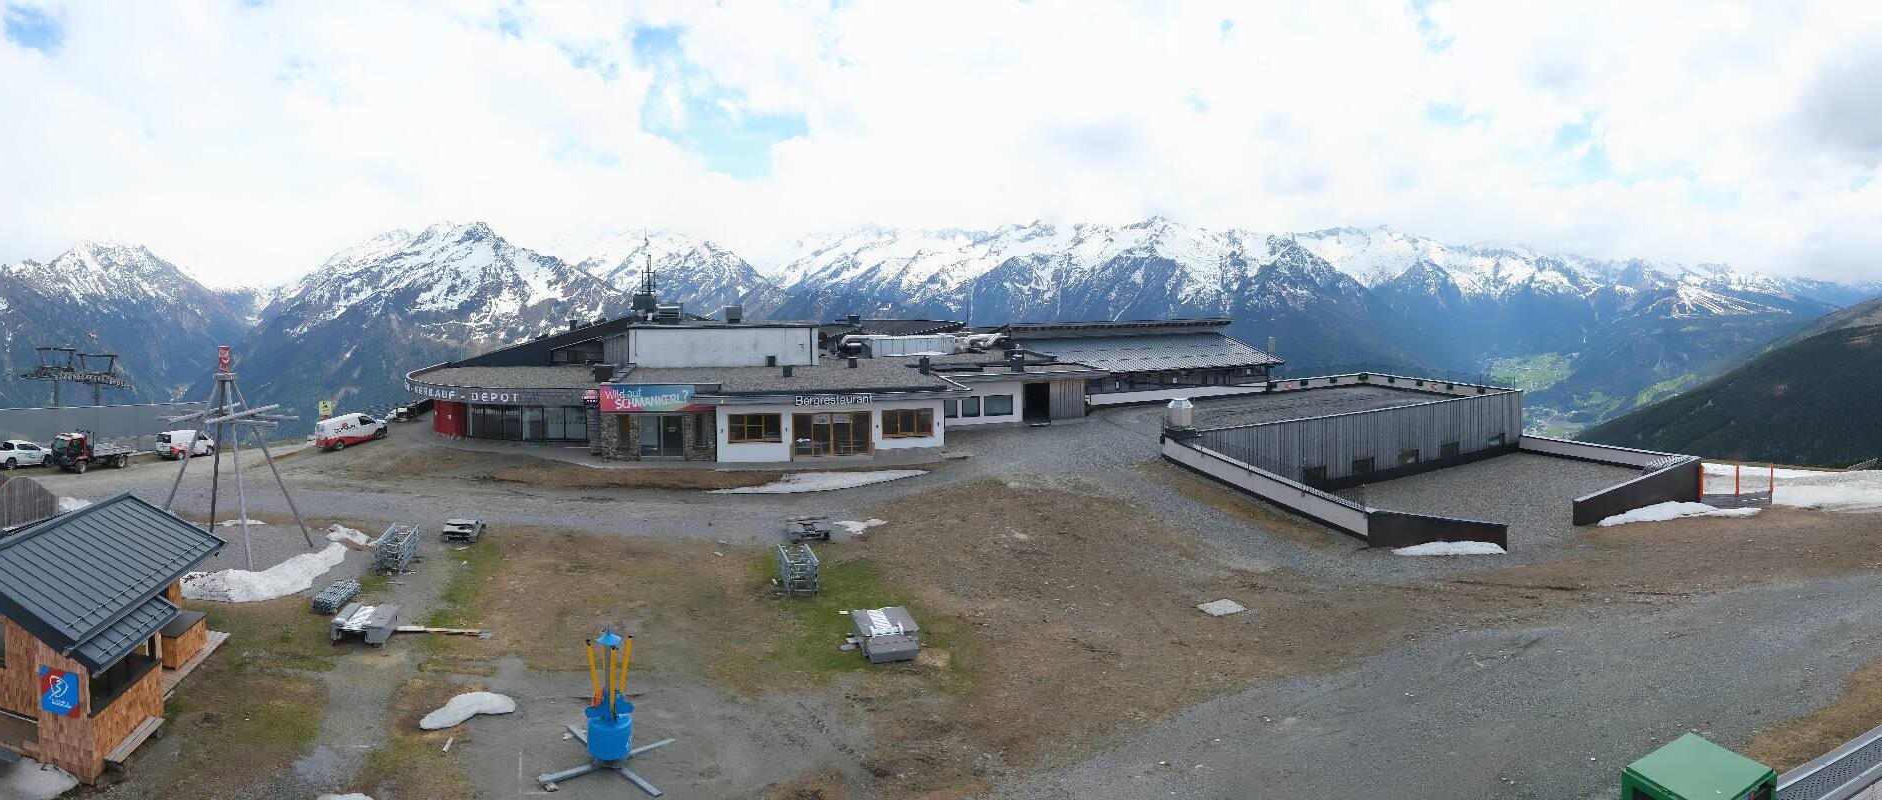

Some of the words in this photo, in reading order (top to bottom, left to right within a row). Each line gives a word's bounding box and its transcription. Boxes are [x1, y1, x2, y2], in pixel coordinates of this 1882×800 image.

[414, 386, 455, 400] VERKAUF
[472, 392, 519, 403] DEPOT
[604, 388, 625, 400] Wild
[627, 386, 642, 398] auf
[614, 389, 689, 410] SCHMANKERL?
[795, 394, 873, 407] Bergrestaurant
